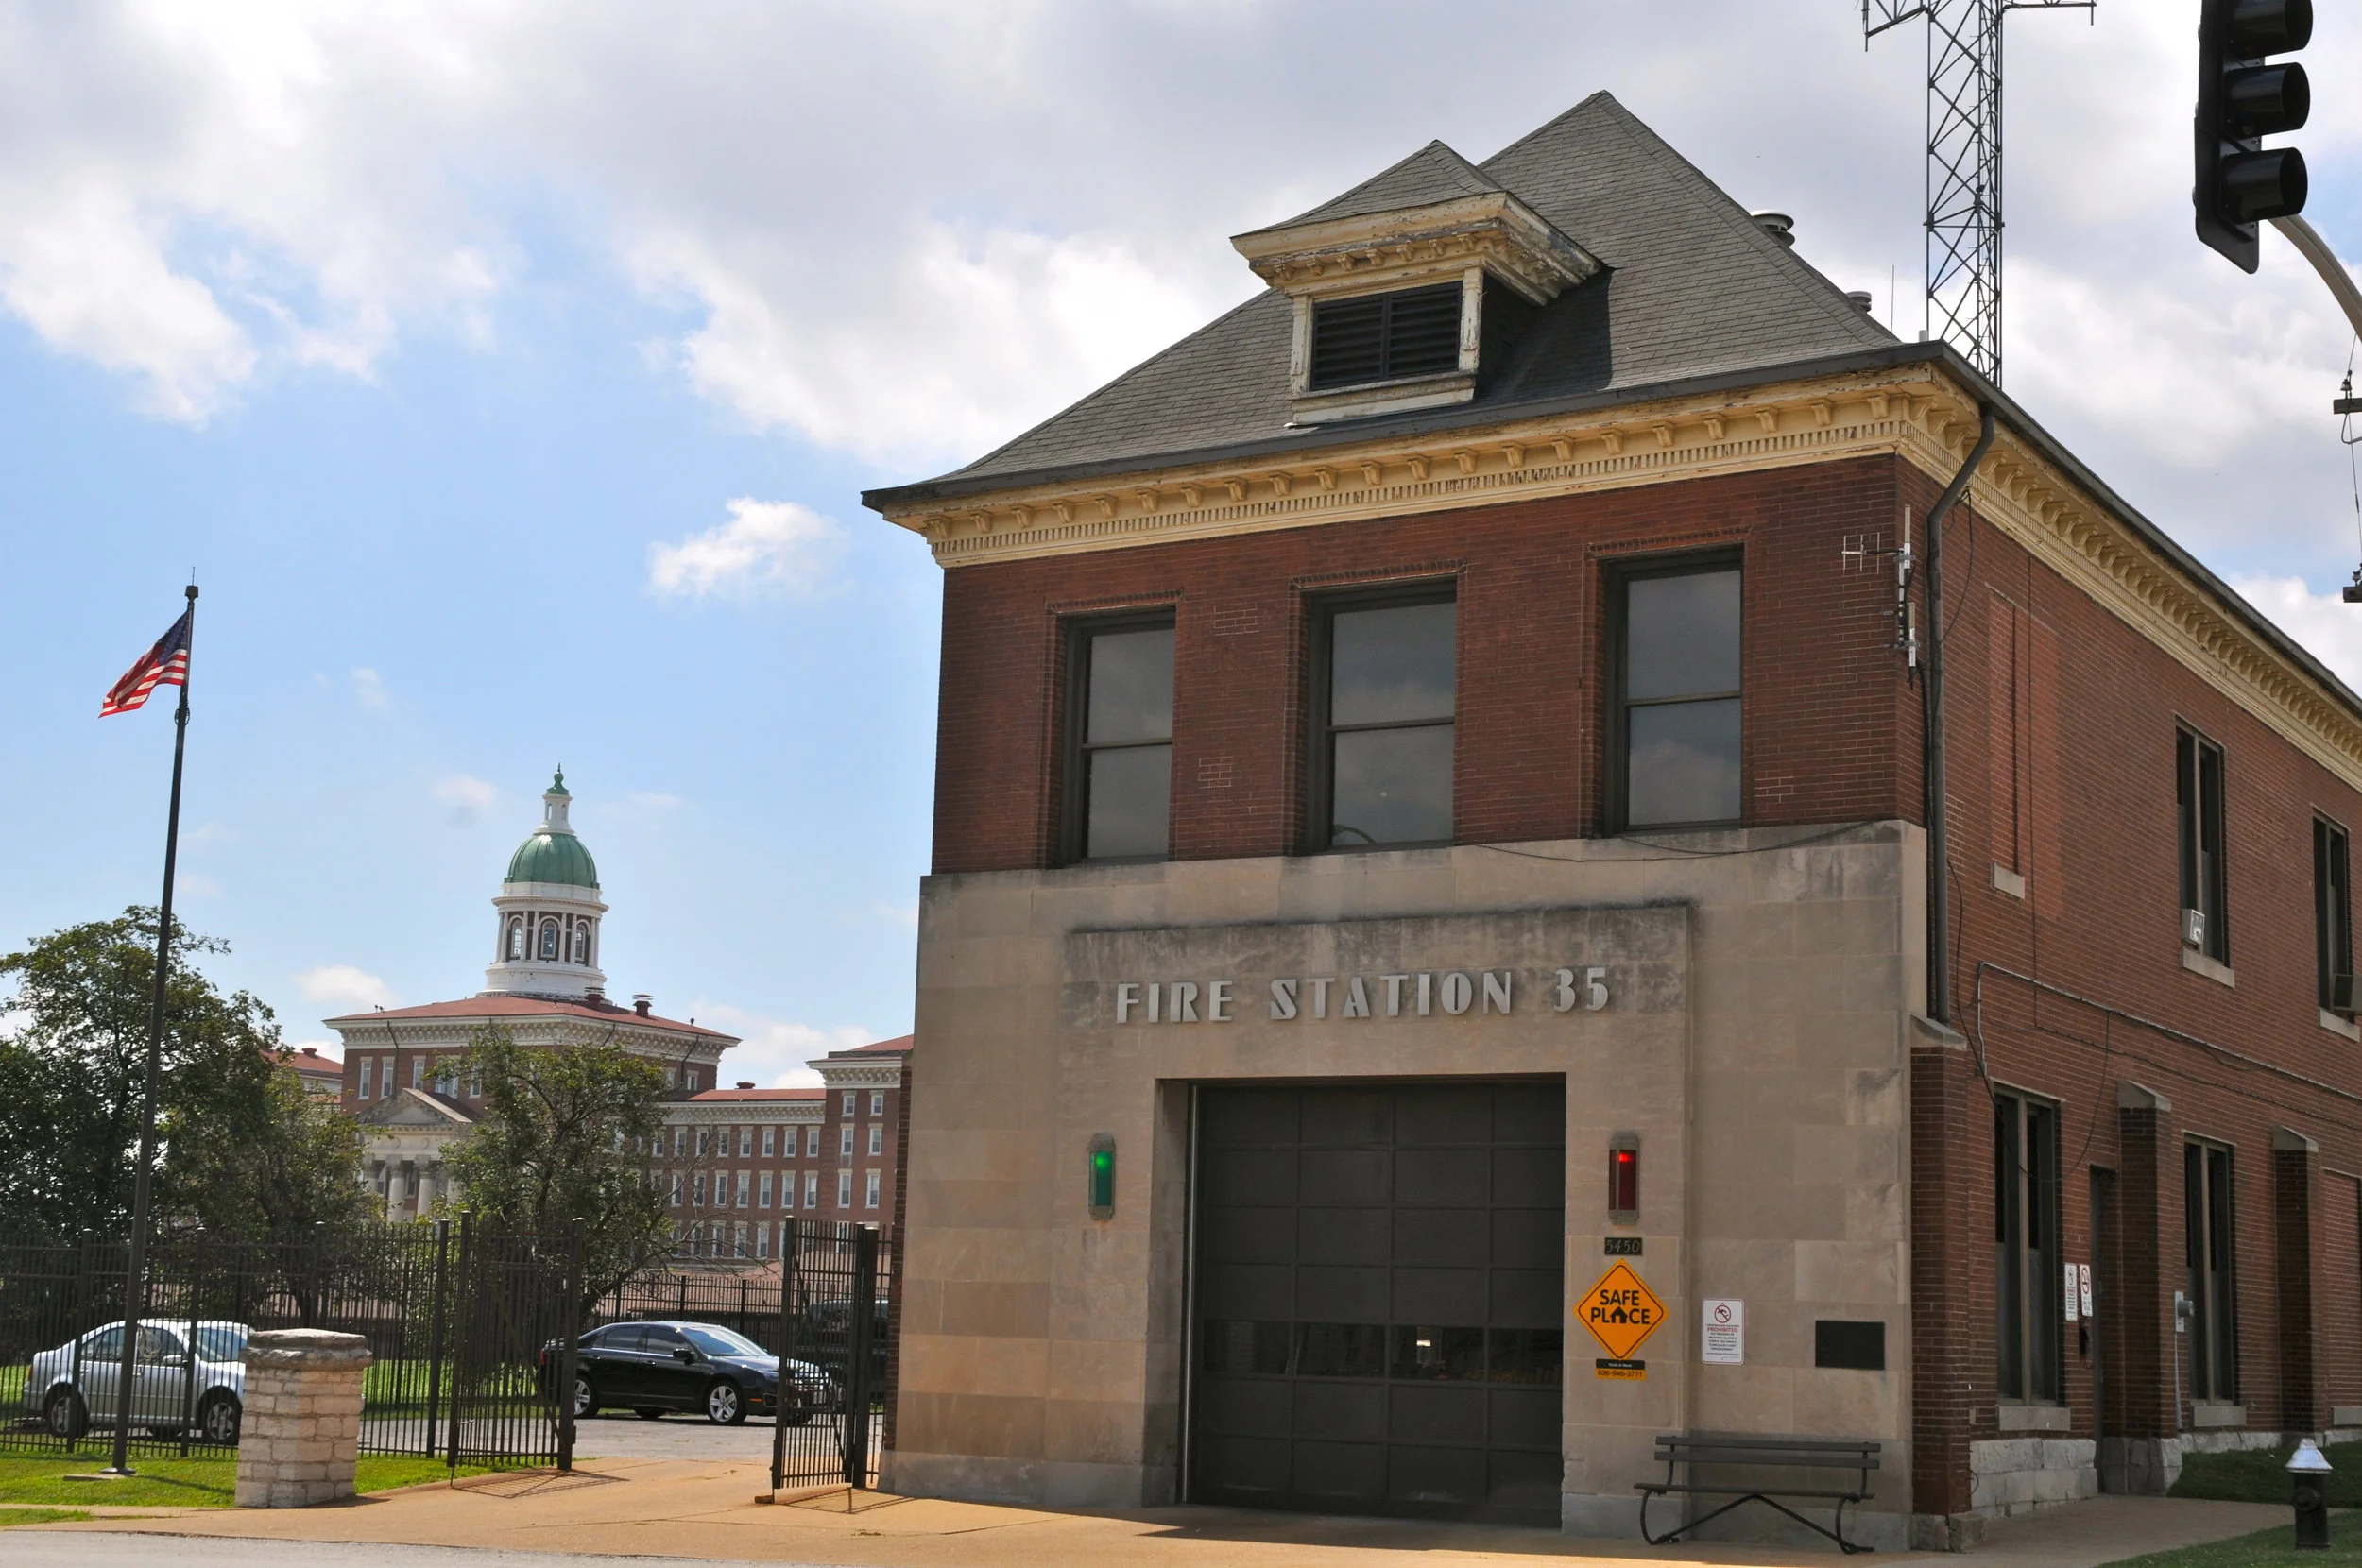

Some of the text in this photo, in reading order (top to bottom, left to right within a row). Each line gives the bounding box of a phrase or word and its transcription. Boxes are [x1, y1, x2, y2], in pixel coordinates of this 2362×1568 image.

[1116, 966, 1609, 1024] FIRE STATION 35
[1606, 1239, 1640, 1253] 5450
[1600, 1289, 1640, 1306] SAFE
